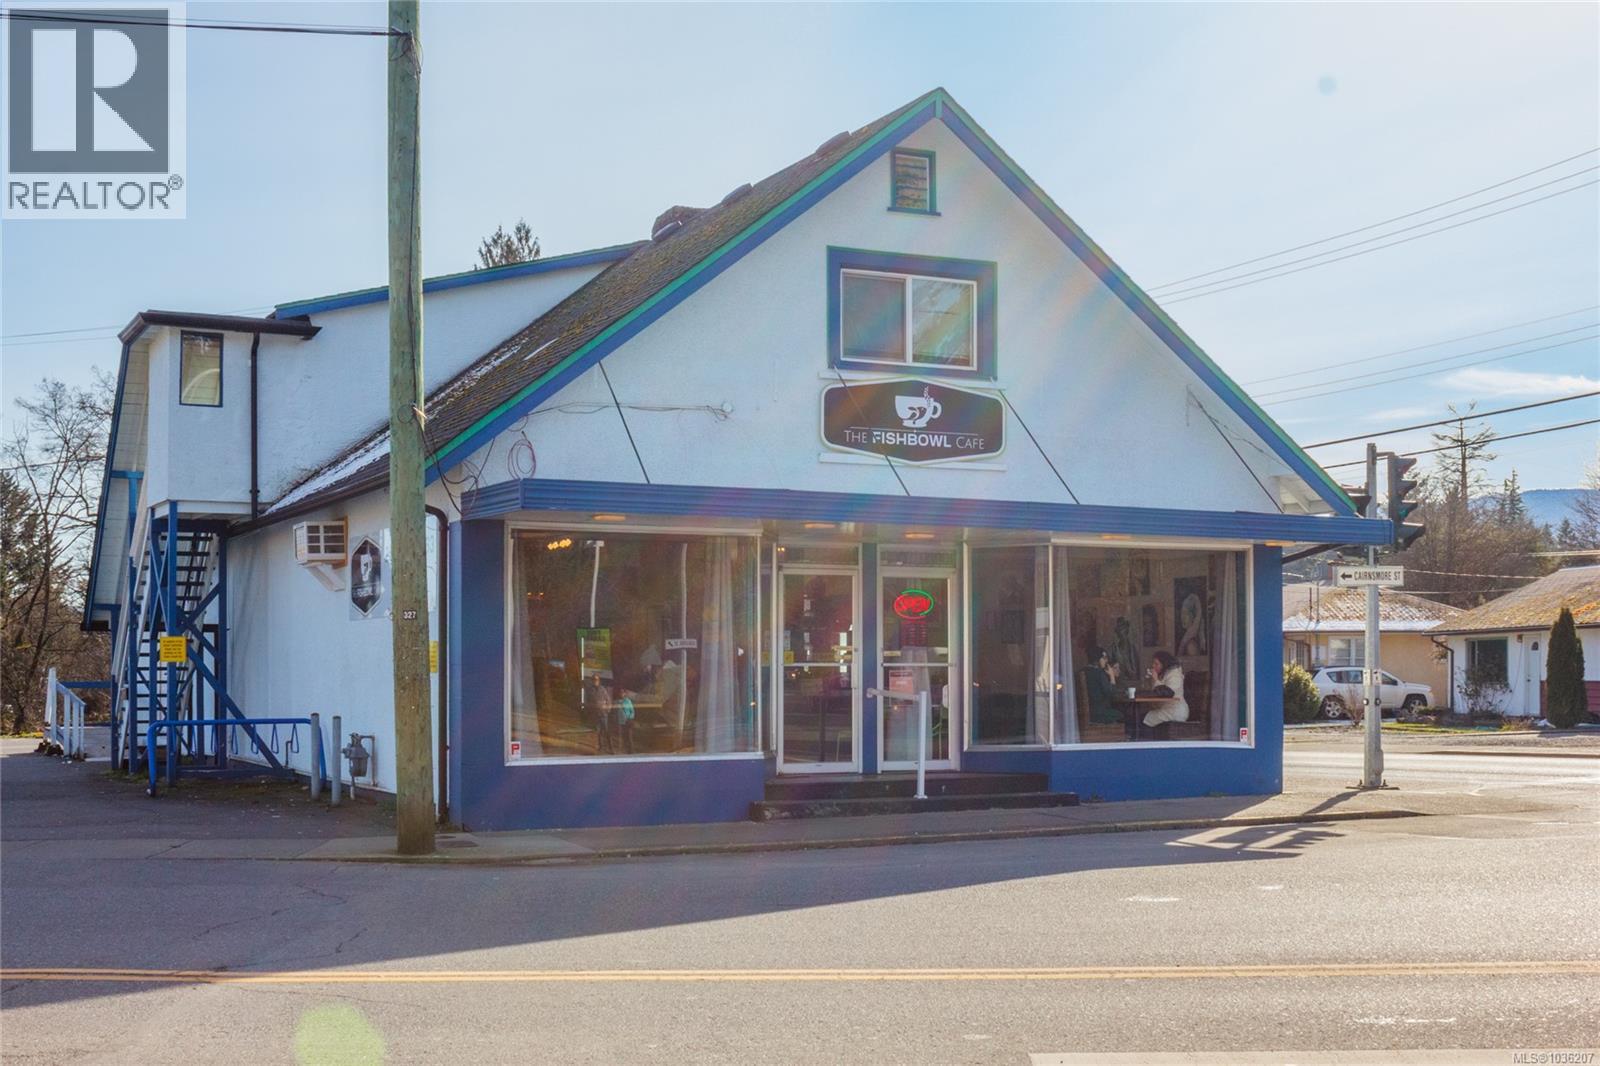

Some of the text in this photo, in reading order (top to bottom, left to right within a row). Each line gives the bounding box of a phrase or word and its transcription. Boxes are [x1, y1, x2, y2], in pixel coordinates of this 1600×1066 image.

[844, 430, 985, 450] THE FISHBOWL CAFE
[1354, 571, 1401, 581] CAIRNSMORE ST
[403, 610, 417, 619] 327
